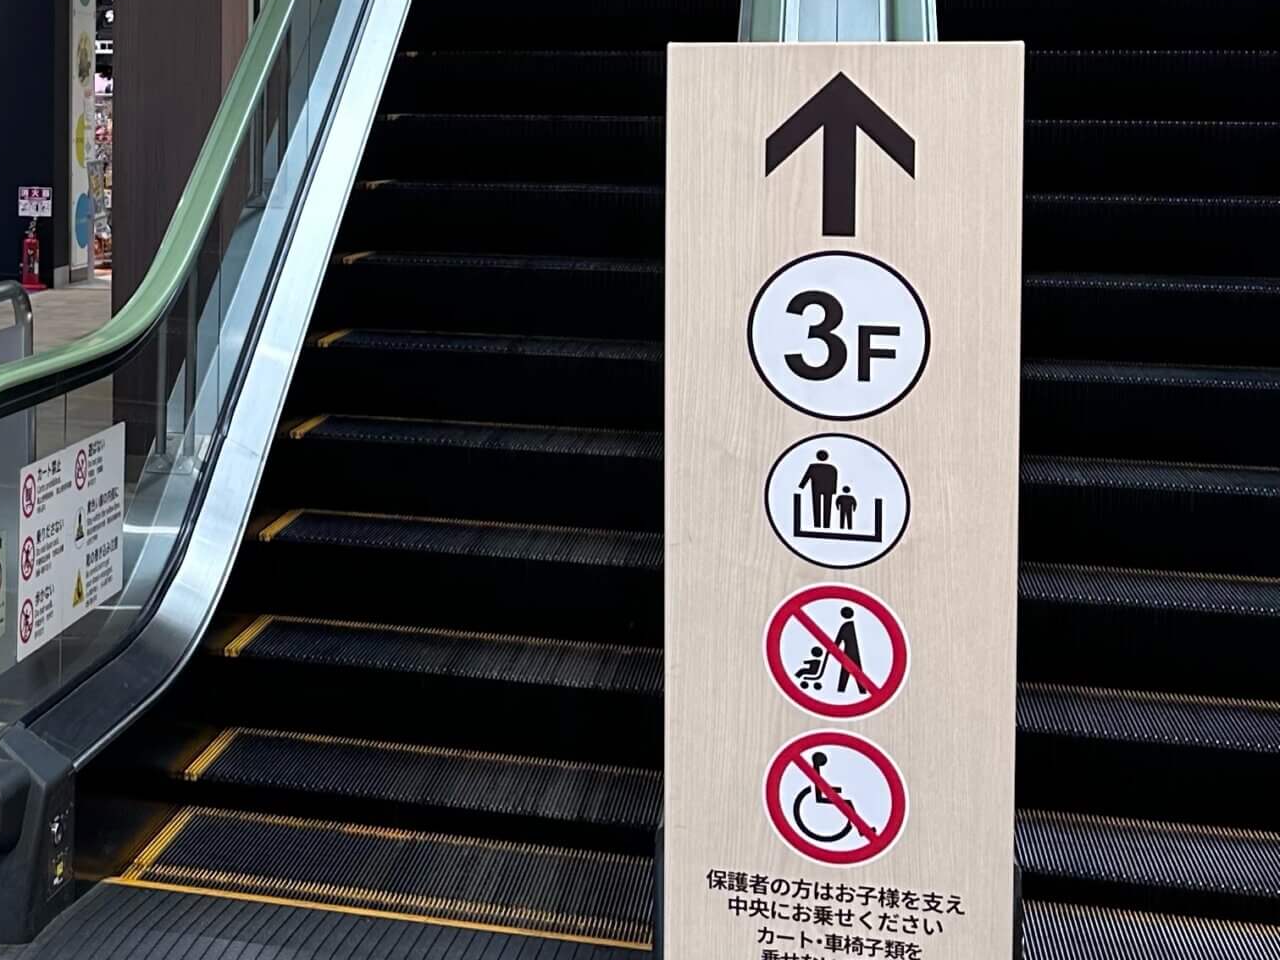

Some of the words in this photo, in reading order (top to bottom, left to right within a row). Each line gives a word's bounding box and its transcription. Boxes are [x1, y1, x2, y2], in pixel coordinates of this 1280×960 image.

[783, 289, 901, 382] 3F
[706, 869, 966, 916] 保護者の方はお子様を支え
[727, 895, 944, 936] 中央にお乗せください
